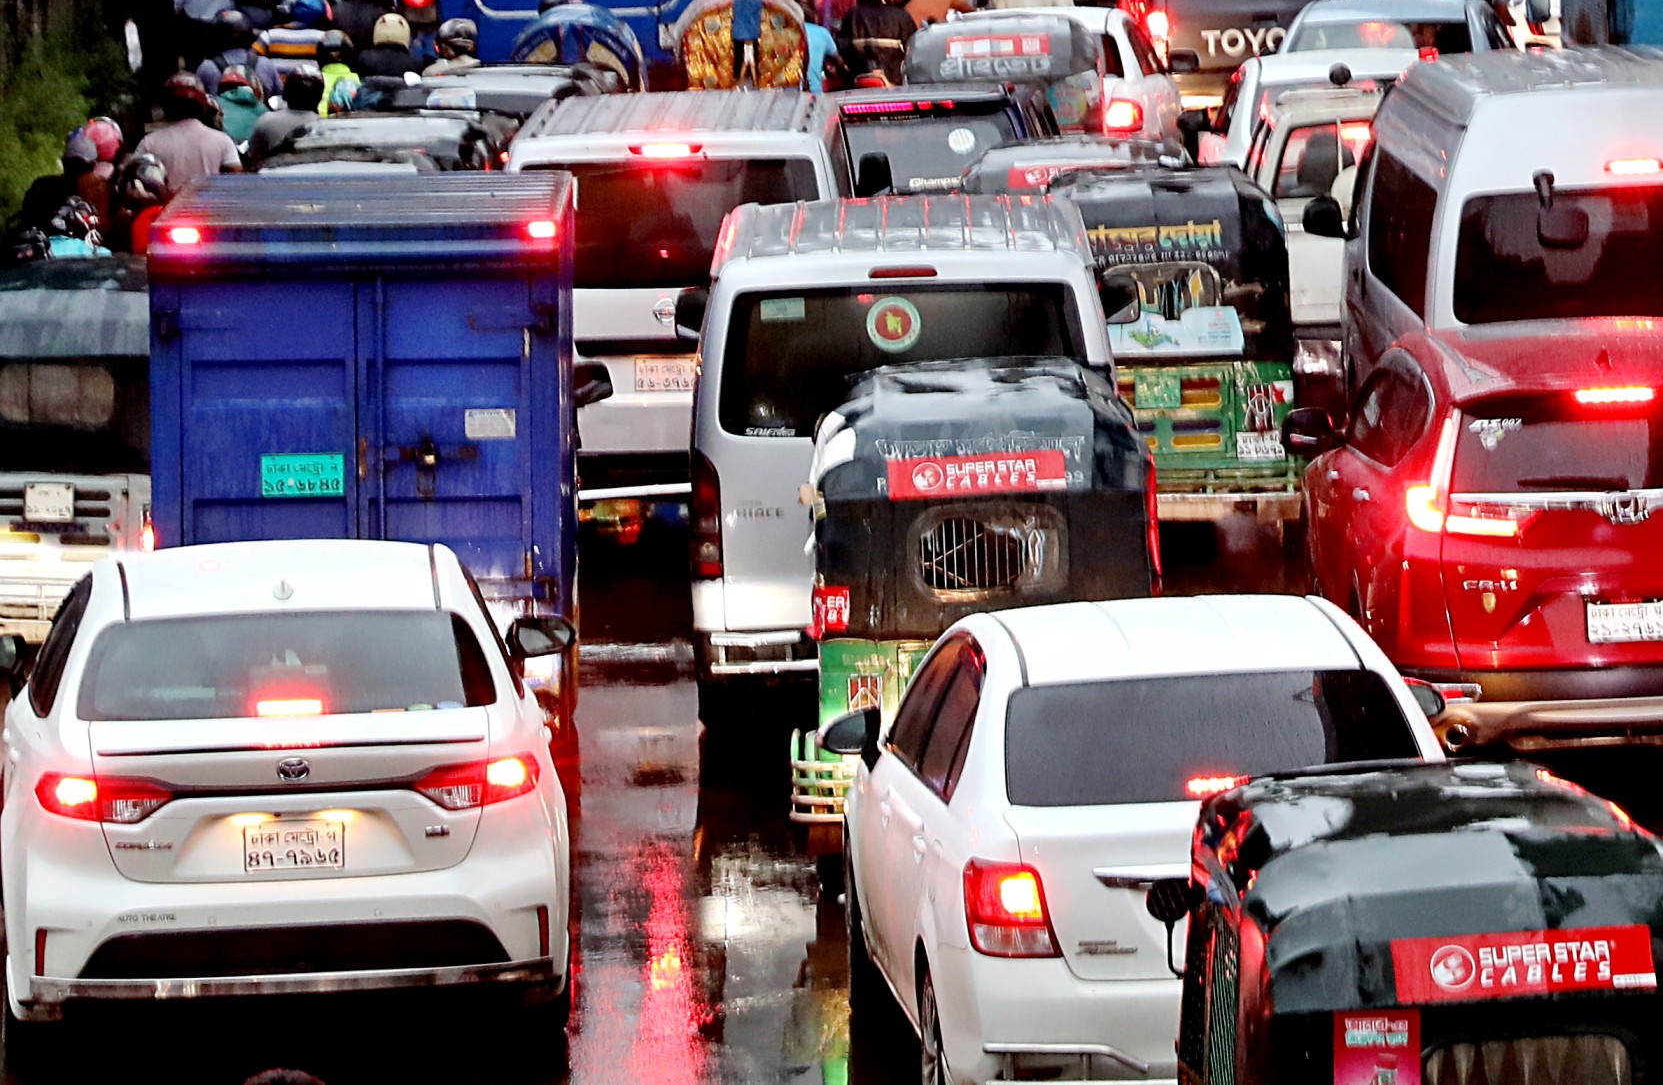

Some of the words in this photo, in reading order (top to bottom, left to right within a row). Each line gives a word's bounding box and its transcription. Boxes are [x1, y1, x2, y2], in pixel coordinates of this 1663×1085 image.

[1201, 26, 1287, 57] TOYO
[945, 460, 995, 475] SUPER
[997, 458, 1037, 473] STAR
[945, 471, 1036, 489] CABLES
[250, 831, 279, 845] ঢাকা
[248, 848, 340, 867] ৪৭-৭৯৬৫
[1478, 943, 1551, 966] SUPER
[1553, 940, 1611, 963] STAR
[1480, 961, 1612, 988] CABLES
